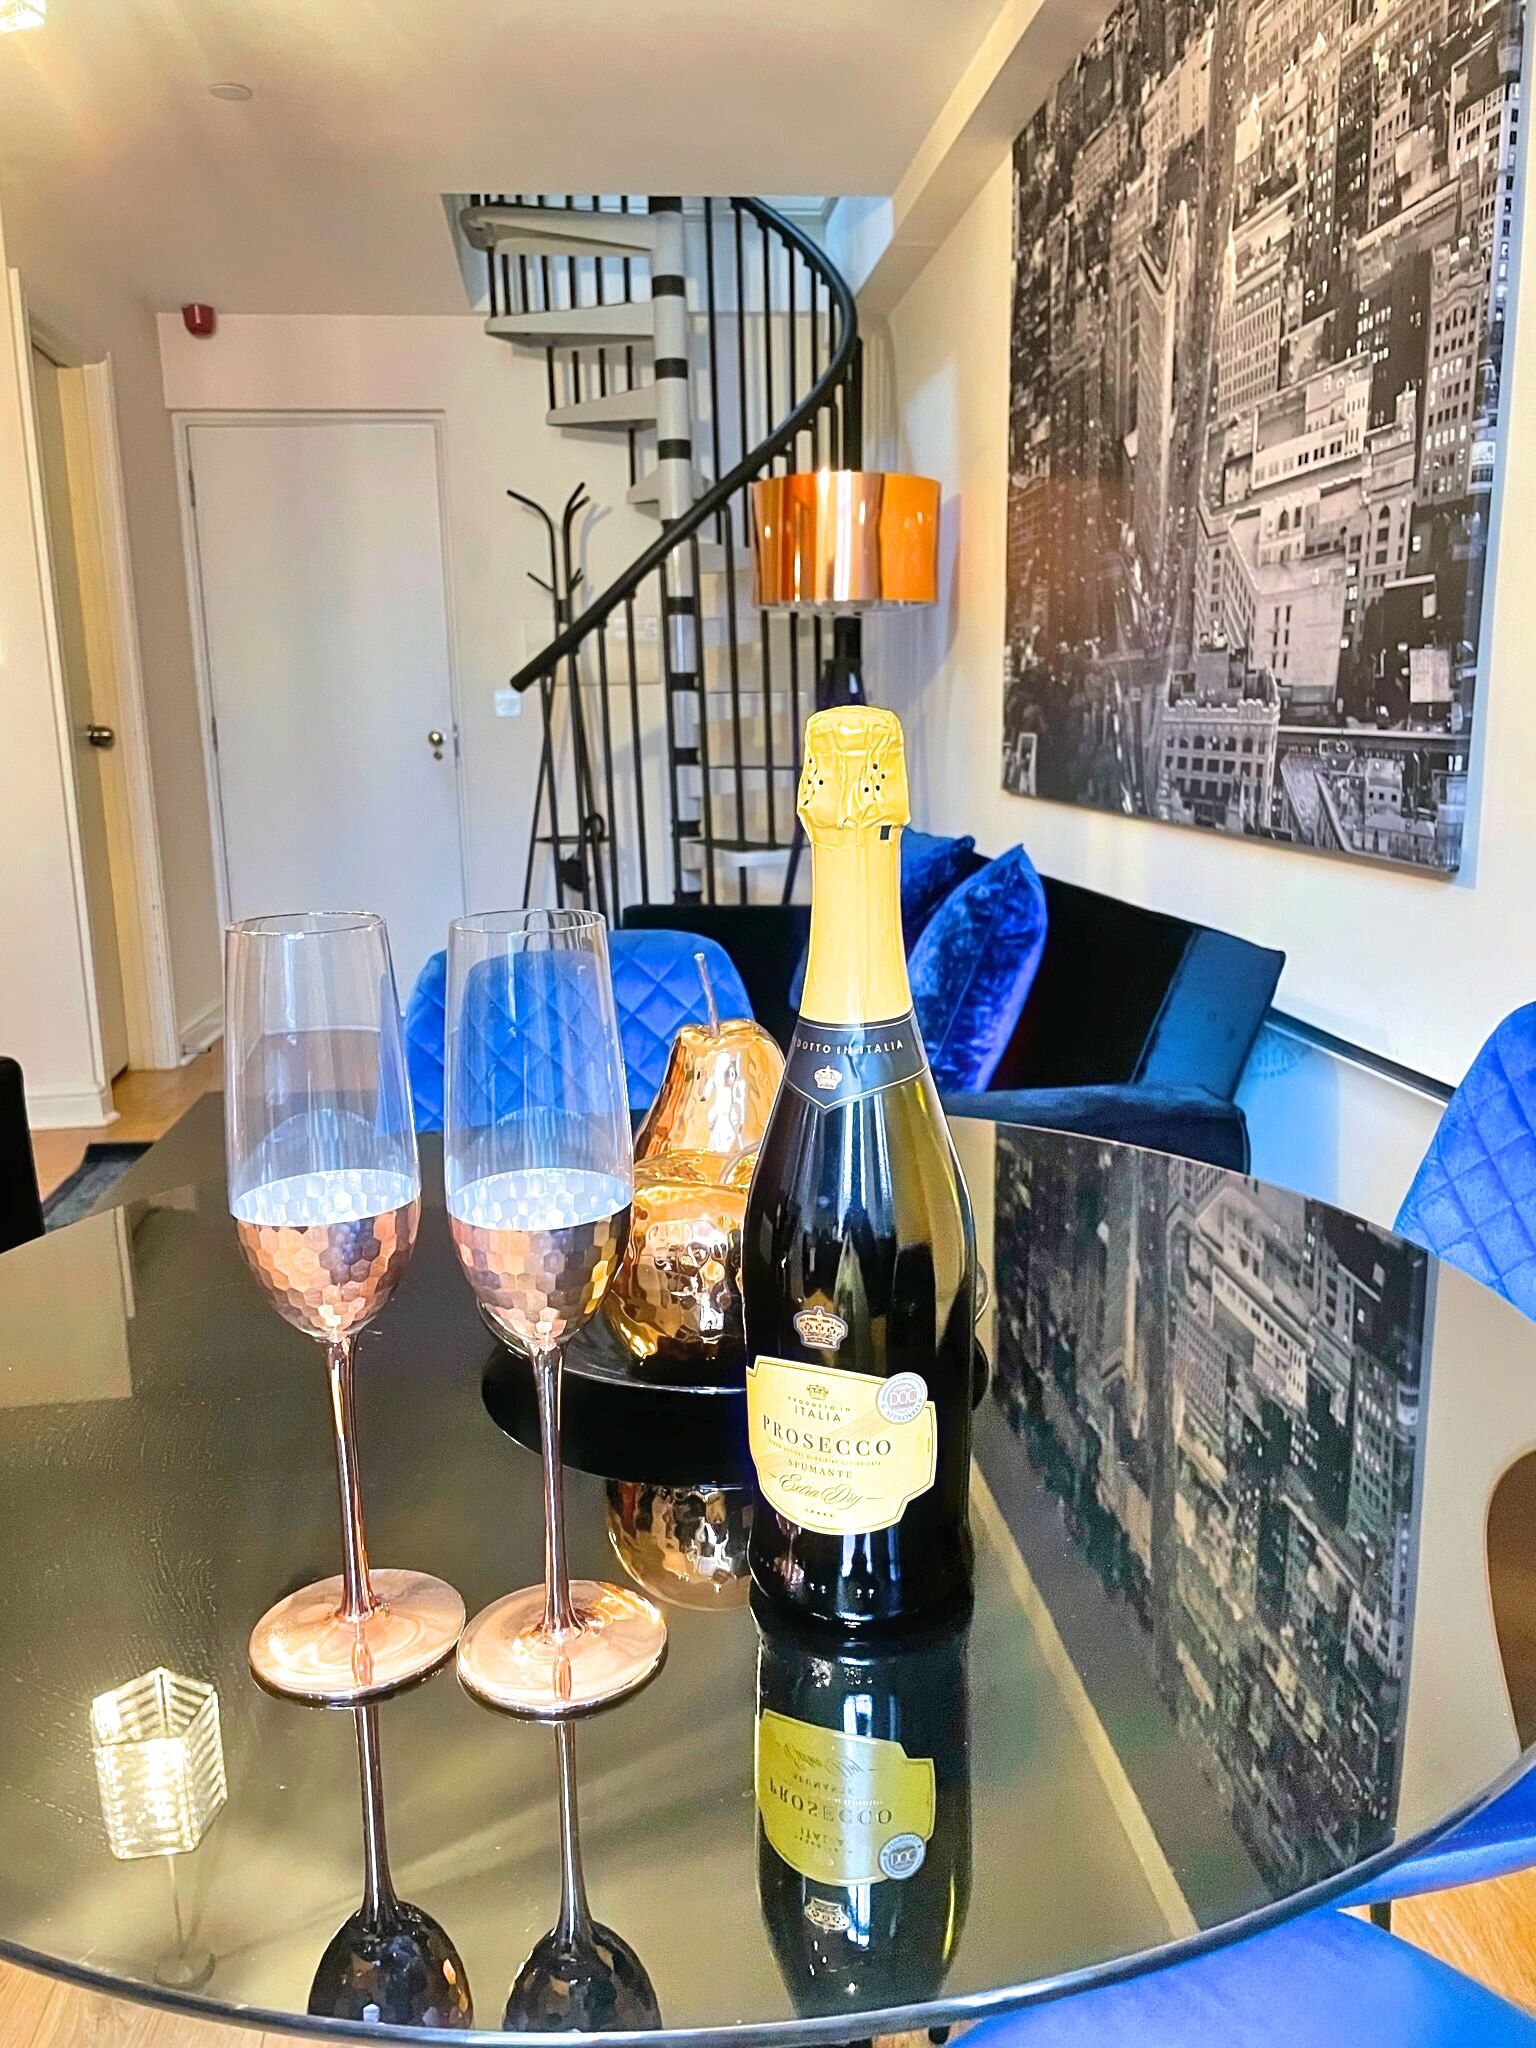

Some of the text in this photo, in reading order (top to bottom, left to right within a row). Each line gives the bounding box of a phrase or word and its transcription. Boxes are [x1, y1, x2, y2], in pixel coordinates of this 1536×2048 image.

[859, 1039, 904, 1055] ITALIA
[890, 1388, 918, 1406] DOC
[794, 1405, 841, 1422] ITALIA
[763, 1413, 892, 1456] PROSECCO
[788, 1458, 852, 1479] SPUMANTE
[779, 1473, 864, 1510] Extra Dry
